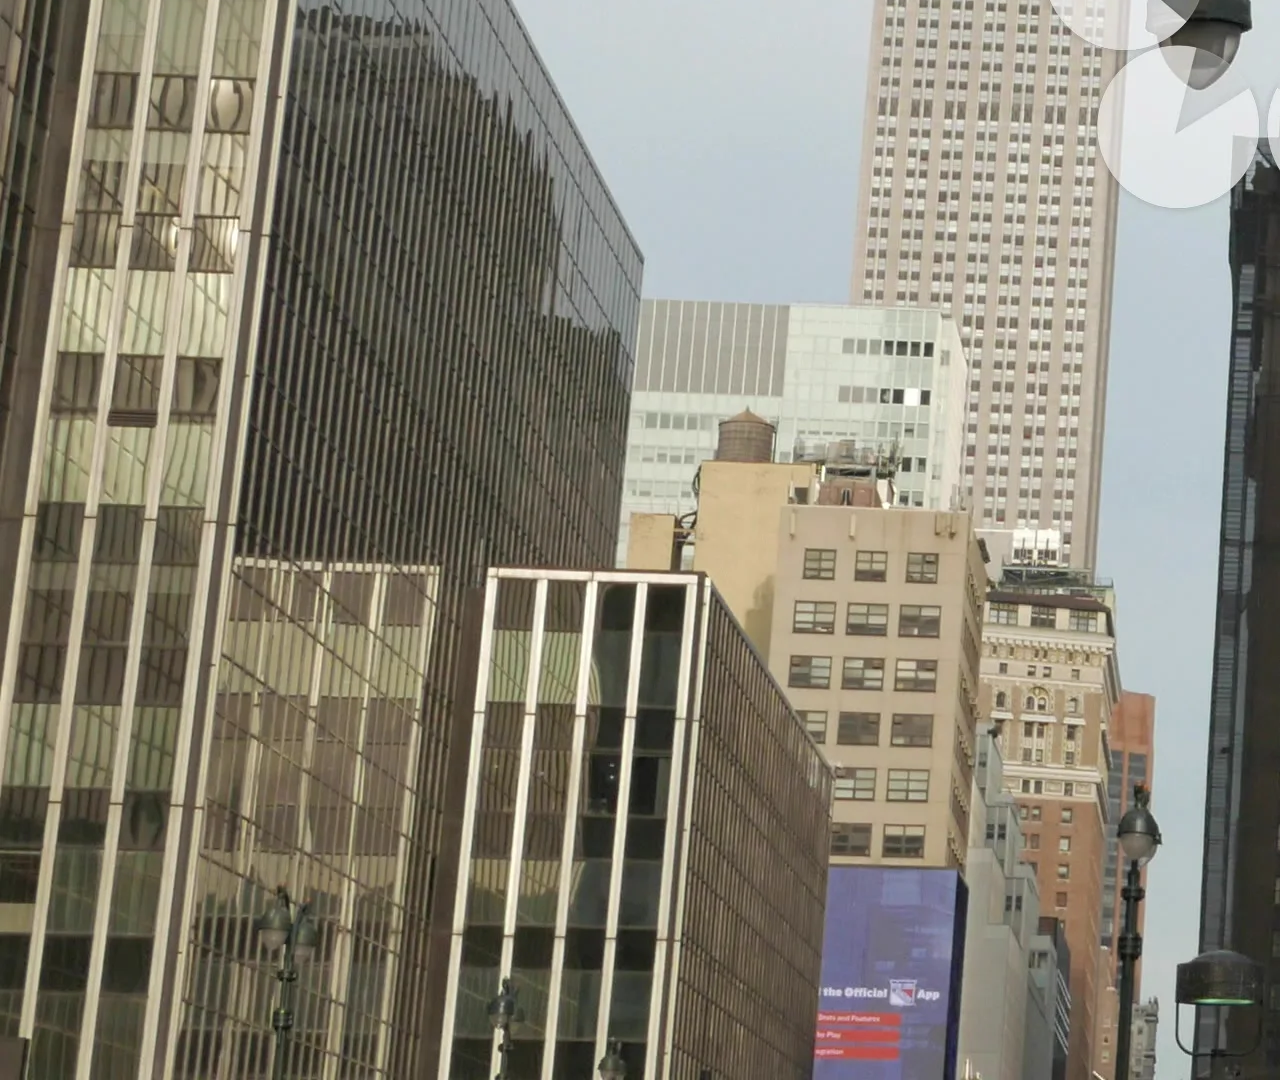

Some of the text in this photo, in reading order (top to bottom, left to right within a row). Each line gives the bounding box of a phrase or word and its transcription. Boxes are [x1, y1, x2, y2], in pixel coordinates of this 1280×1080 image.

[823, 987, 842, 997] the
[844, 986, 888, 998] Official
[916, 988, 940, 1001] App
